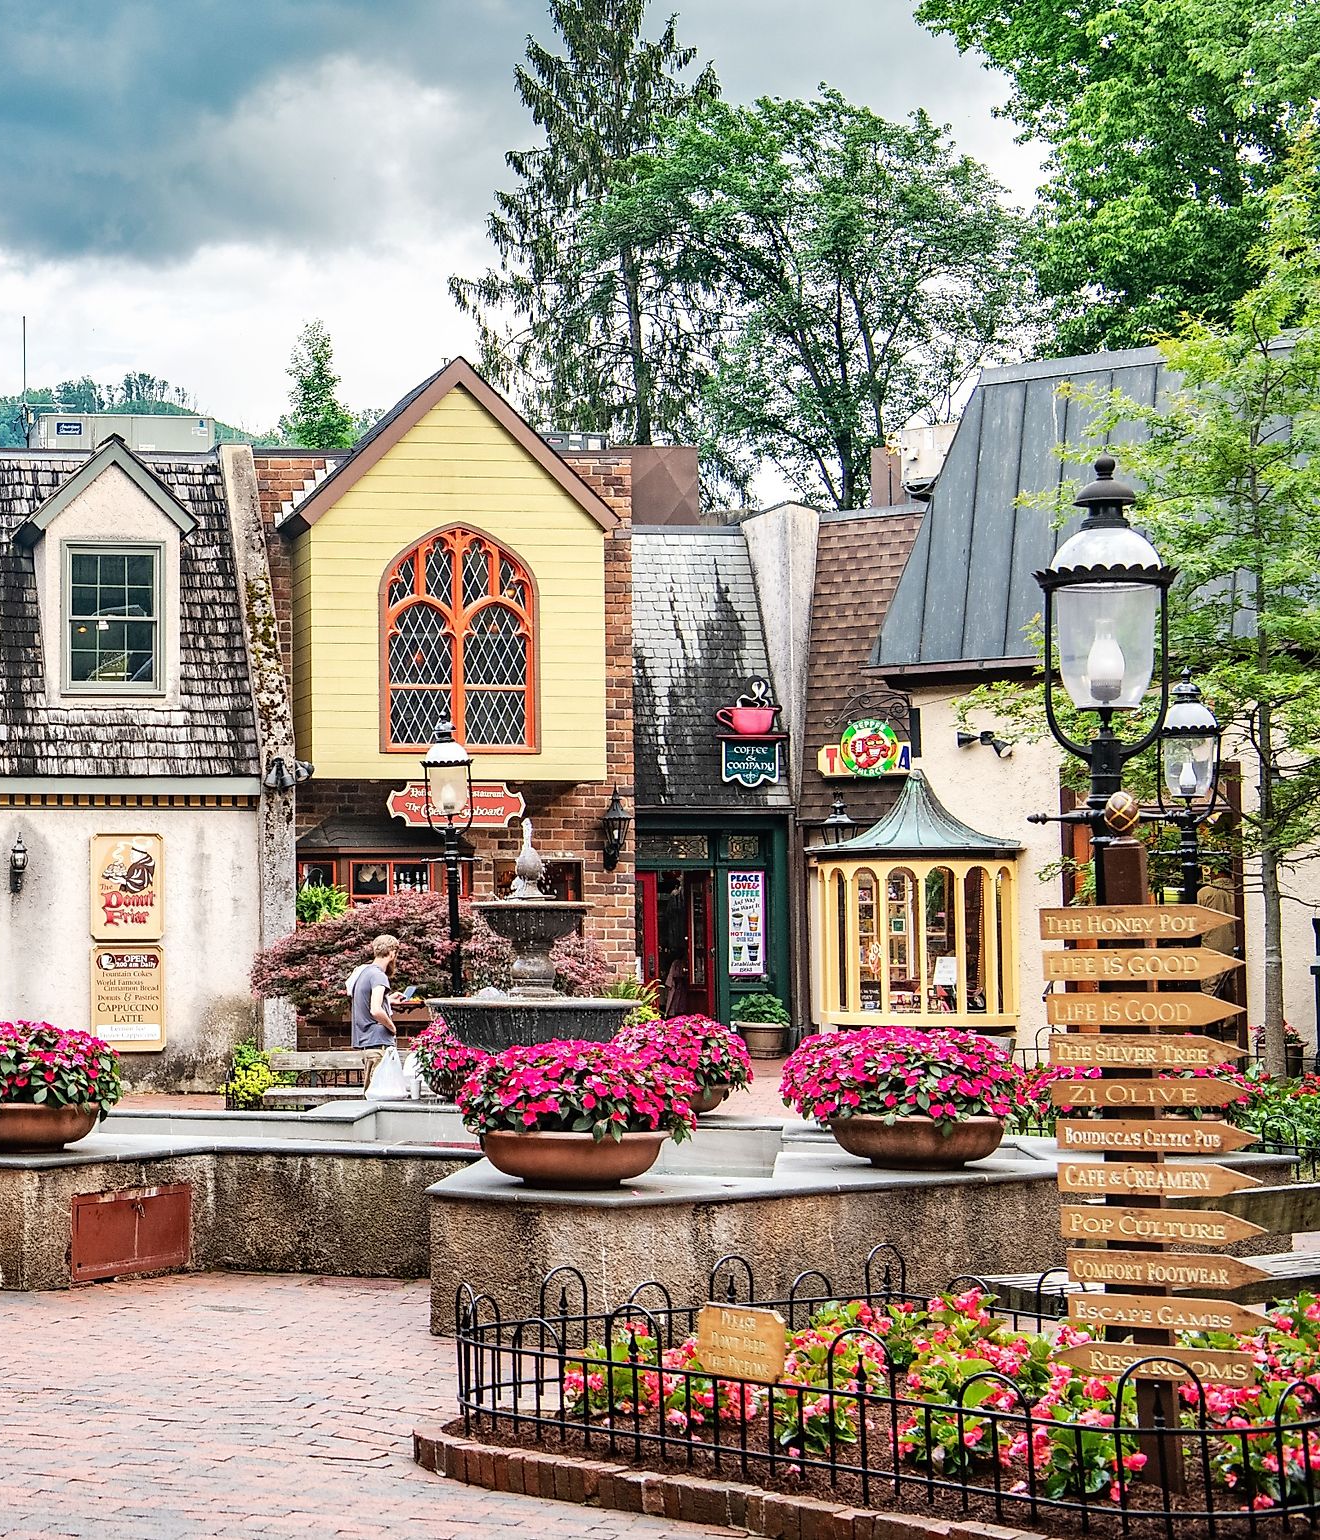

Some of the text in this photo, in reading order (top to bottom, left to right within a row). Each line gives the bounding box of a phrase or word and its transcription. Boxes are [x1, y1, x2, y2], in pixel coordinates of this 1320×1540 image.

[853, 721, 886, 731] PEPPER
[853, 765, 886, 776] PALACE
[405, 802, 421, 813] The
[730, 874, 760, 882] PEACE
[101, 891, 156, 908] Donut
[102, 907, 149, 926] Friar
[1087, 915, 1154, 934] HONEY
[1049, 955, 1200, 975] LIFE IS GOOD
[123, 992, 132, 1002] &
[113, 1014, 144, 1022] LATTE
[1053, 999, 1192, 1022] LIFE IS GOOD
[1096, 1042, 1158, 1063] SILVER
[1162, 1044, 1209, 1064] TREE
[1105, 1085, 1198, 1104] OLIVE
[1143, 1128, 1191, 1147] CELTIC
[1108, 1171, 1122, 1186] &
[1124, 1167, 1213, 1190] CREAMERY
[1118, 1214, 1227, 1241] CULTURE
[1073, 1258, 1230, 1286] COMFORT FOOTWEAR
[1075, 1299, 1232, 1329] ESCAPE GAMES
[1089, 1350, 1249, 1381] RESTROOMS
